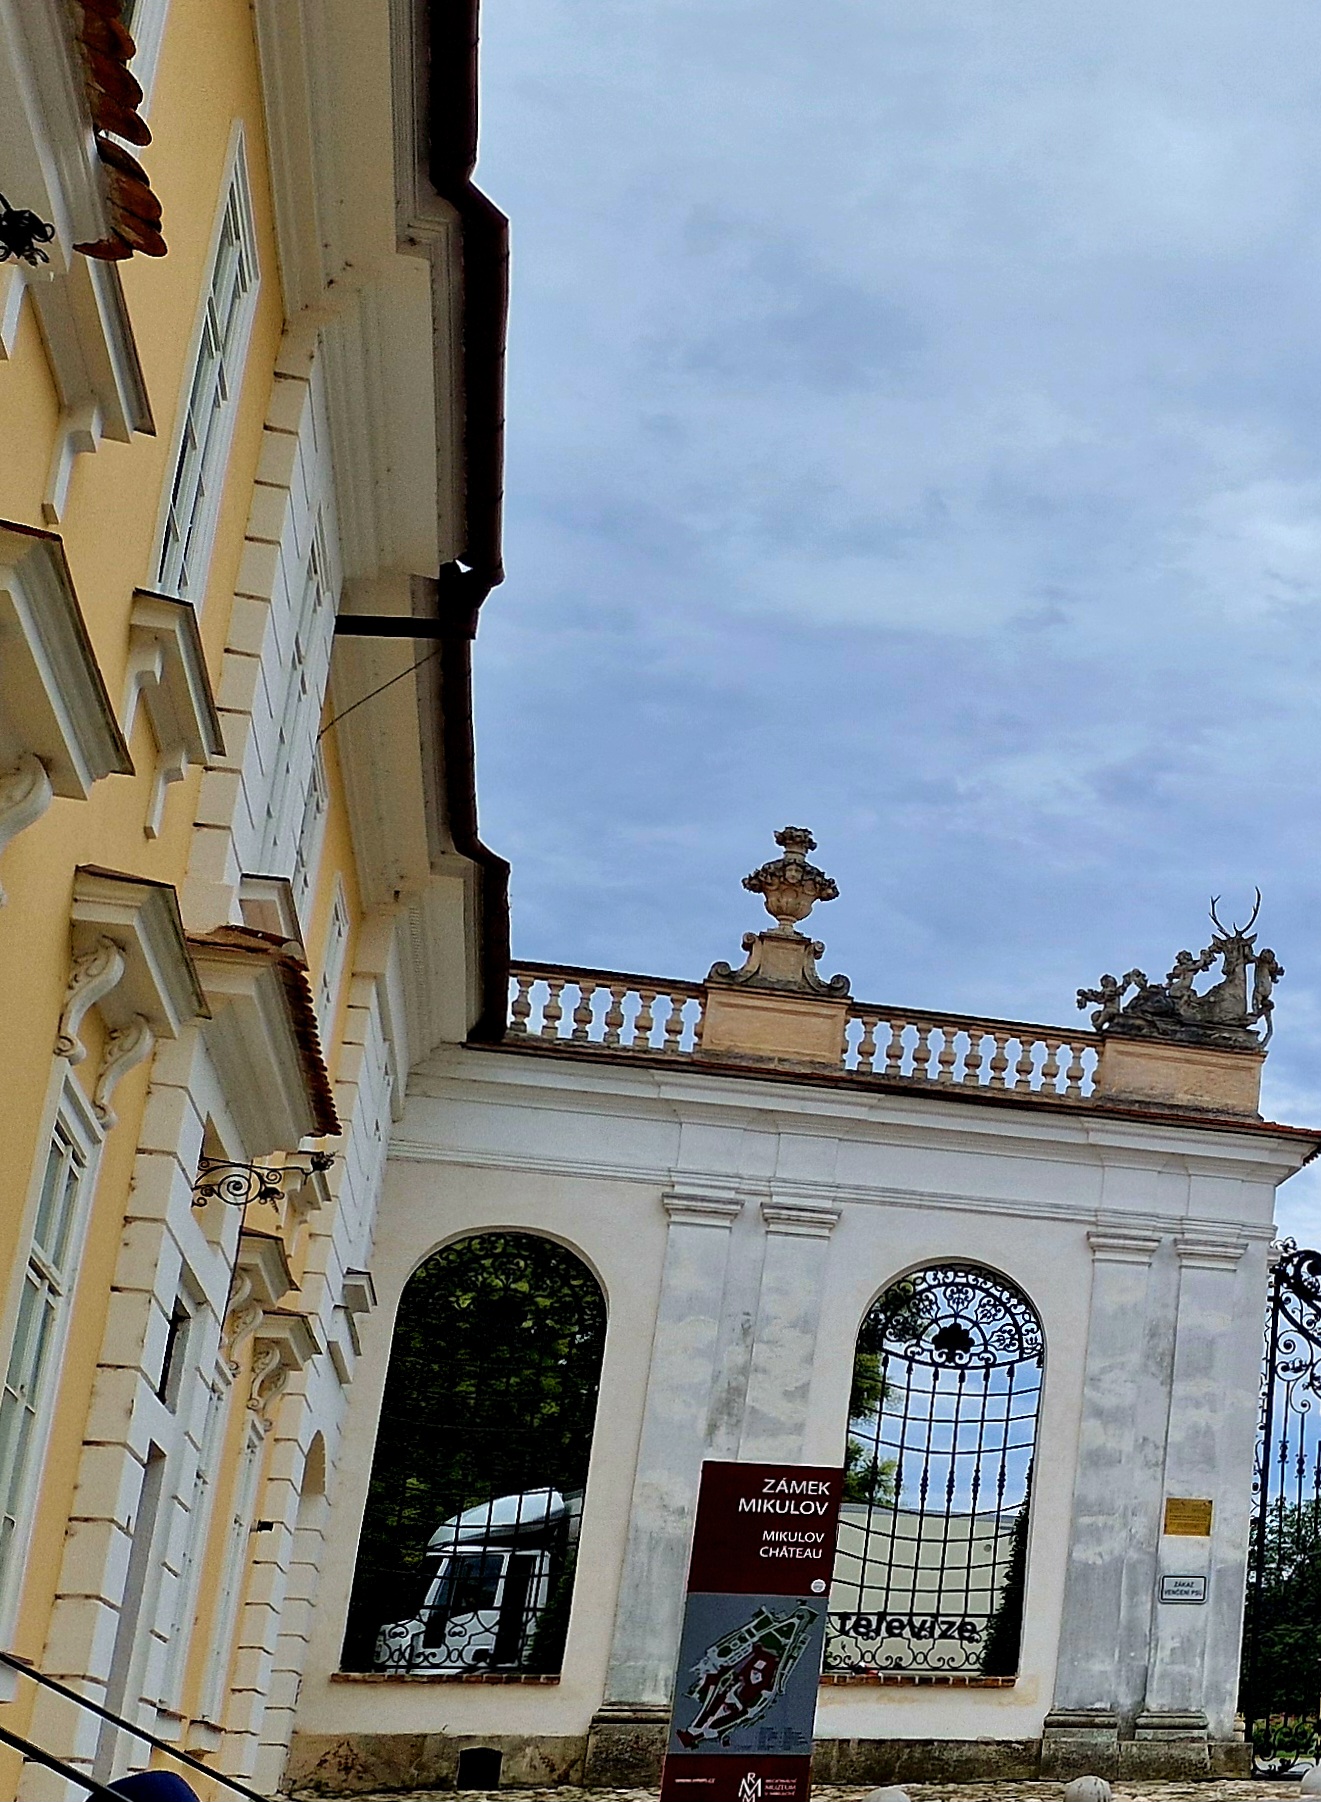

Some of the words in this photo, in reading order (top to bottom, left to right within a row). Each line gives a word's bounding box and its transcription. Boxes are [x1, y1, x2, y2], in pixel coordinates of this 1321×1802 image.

[762, 1477, 831, 1495] ZÁMEK
[738, 1498, 829, 1516] MIKULOV
[762, 1530, 825, 1543] MIKULOV
